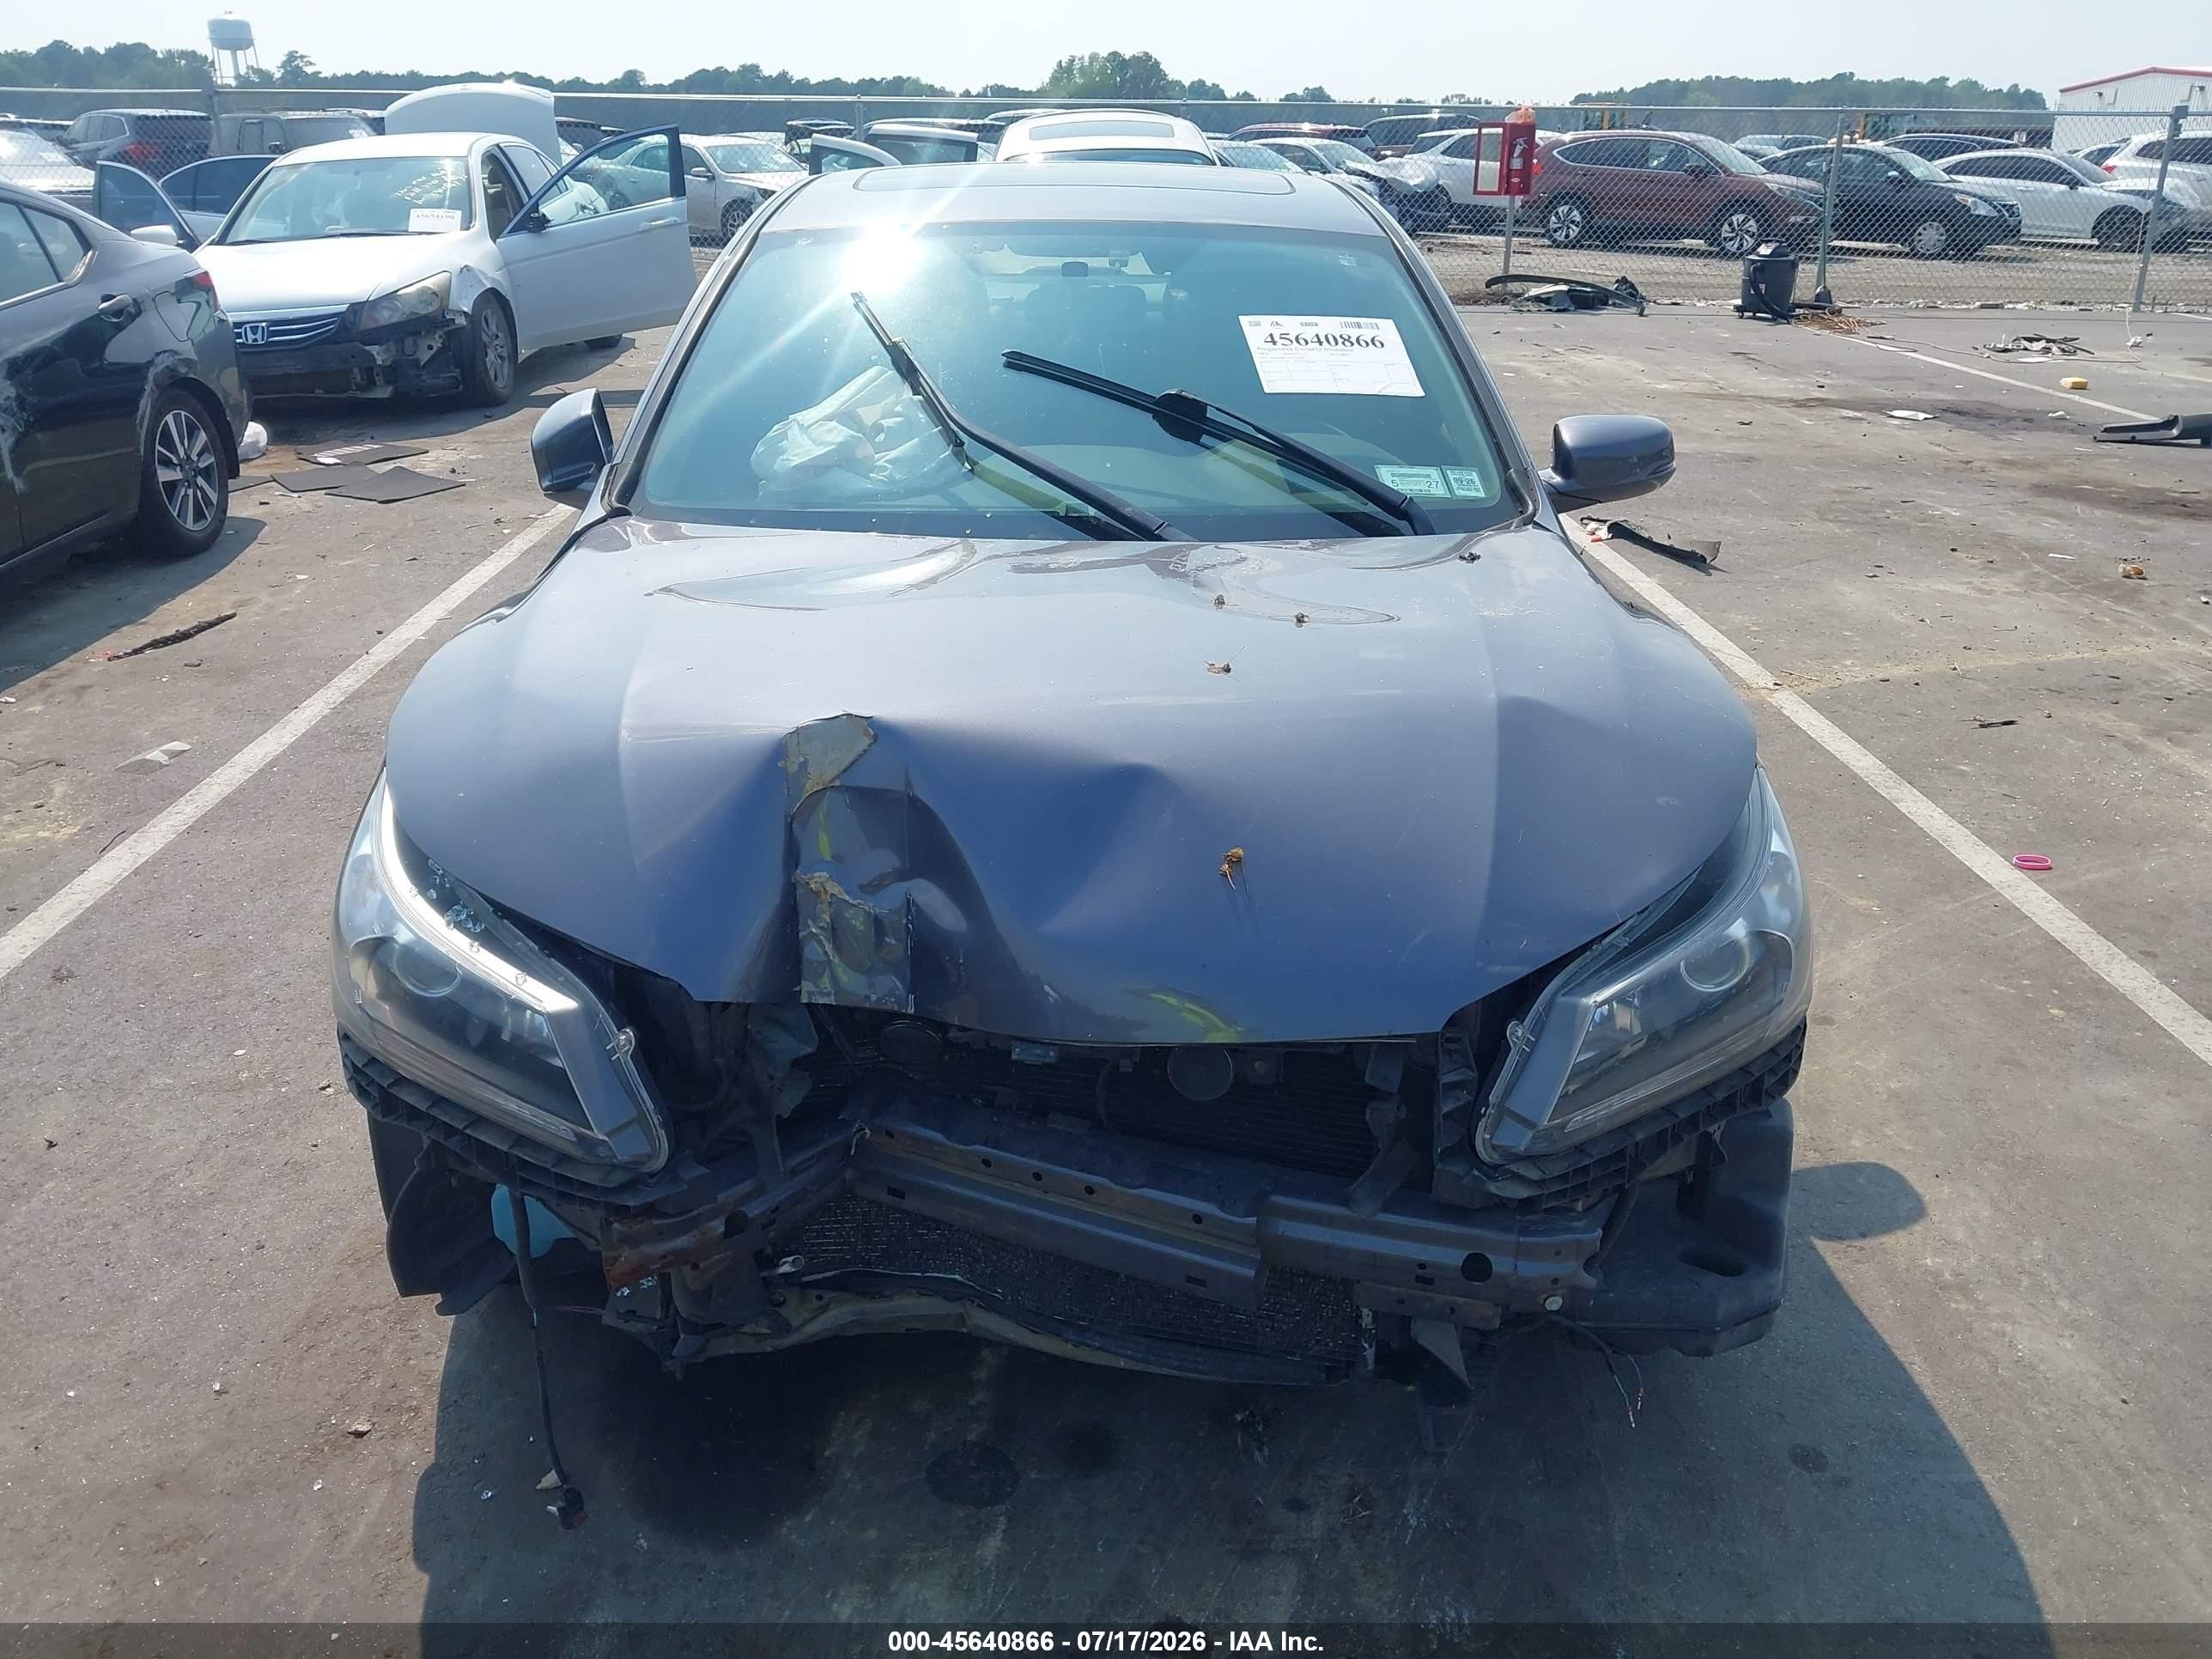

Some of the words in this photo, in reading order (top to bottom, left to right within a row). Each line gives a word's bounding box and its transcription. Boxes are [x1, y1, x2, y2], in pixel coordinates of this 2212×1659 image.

[1263, 332, 1385, 349] 45640866
[1391, 479, 1399, 488] 5
[1425, 480, 1439, 489] 27
